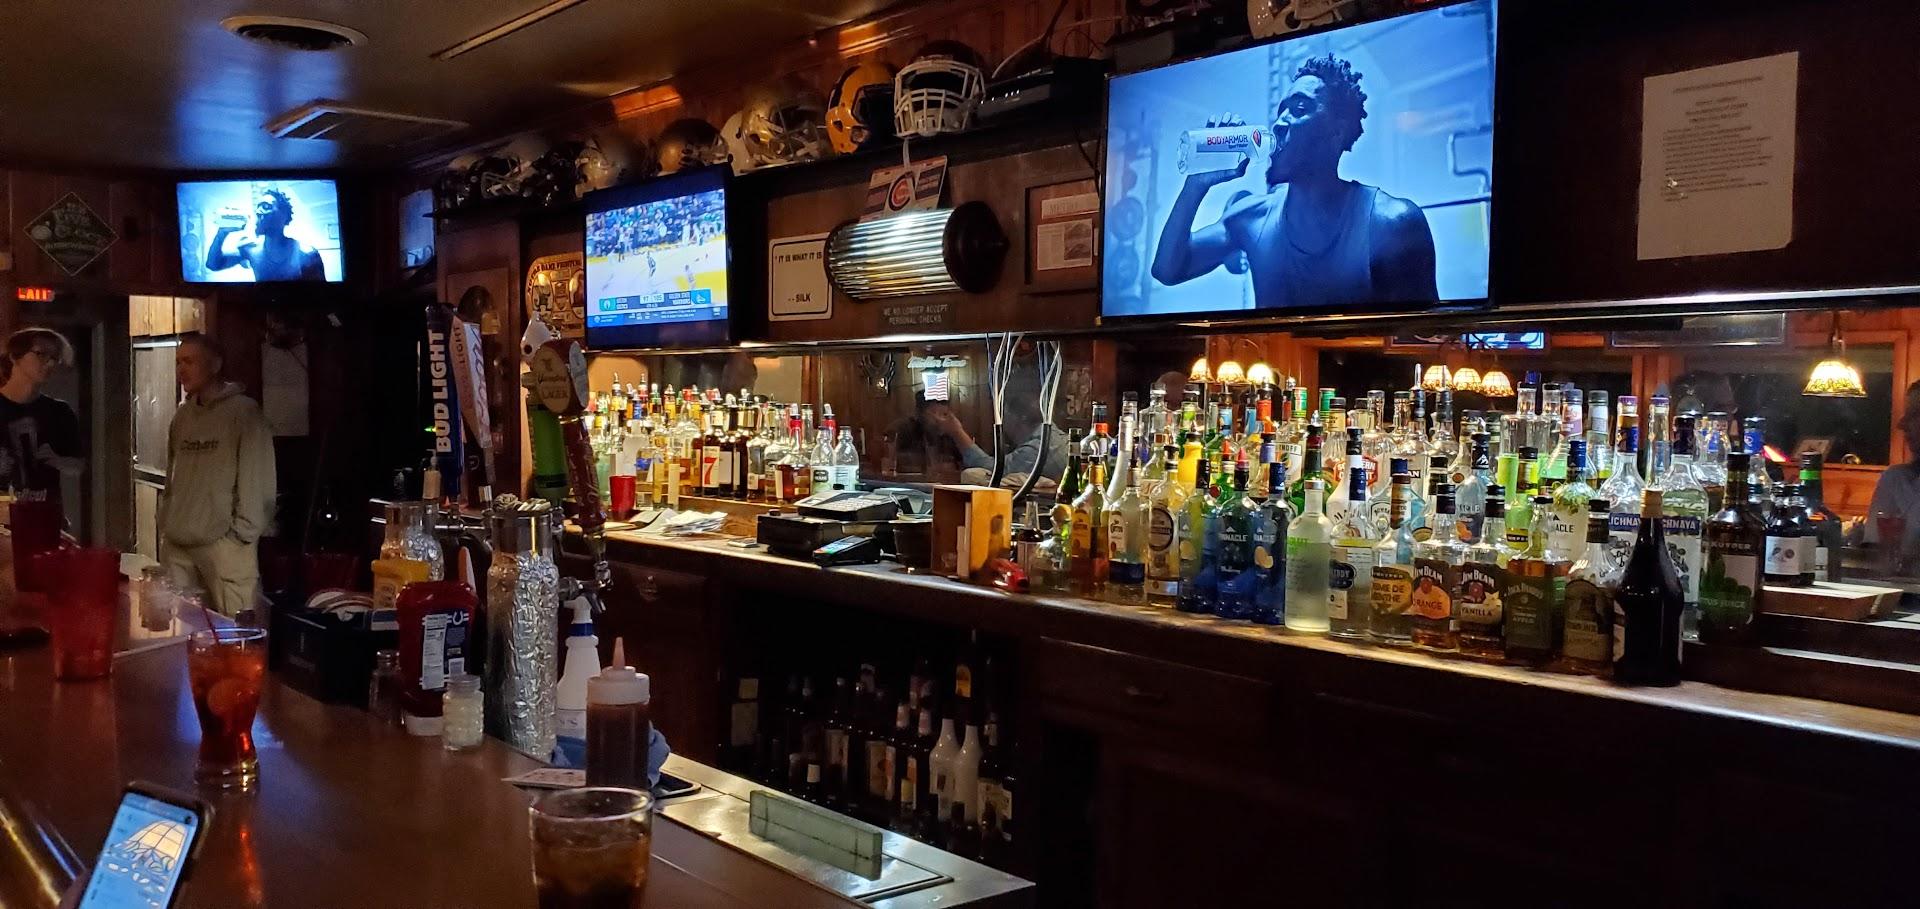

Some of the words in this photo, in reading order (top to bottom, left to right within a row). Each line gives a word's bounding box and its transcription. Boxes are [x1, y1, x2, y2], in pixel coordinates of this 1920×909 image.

[1206, 134, 1248, 145] BODYARMOR
[792, 252, 808, 262] WHAT
[795, 293, 811, 303] SILK
[926, 303, 949, 313] ACCEPT
[889, 315, 918, 325] PERSONAL
[919, 314, 942, 324] CHECKS
[428, 328, 449, 400] LIGHT
[433, 401, 453, 453] BUD
[704, 456, 717, 485] 7
[1424, 565, 1443, 584] BEAM
[1461, 571, 1474, 586] JIM
[1473, 568, 1495, 588] BEAM
[1391, 583, 1405, 593] DE
[1461, 606, 1493, 617] VANILLA
